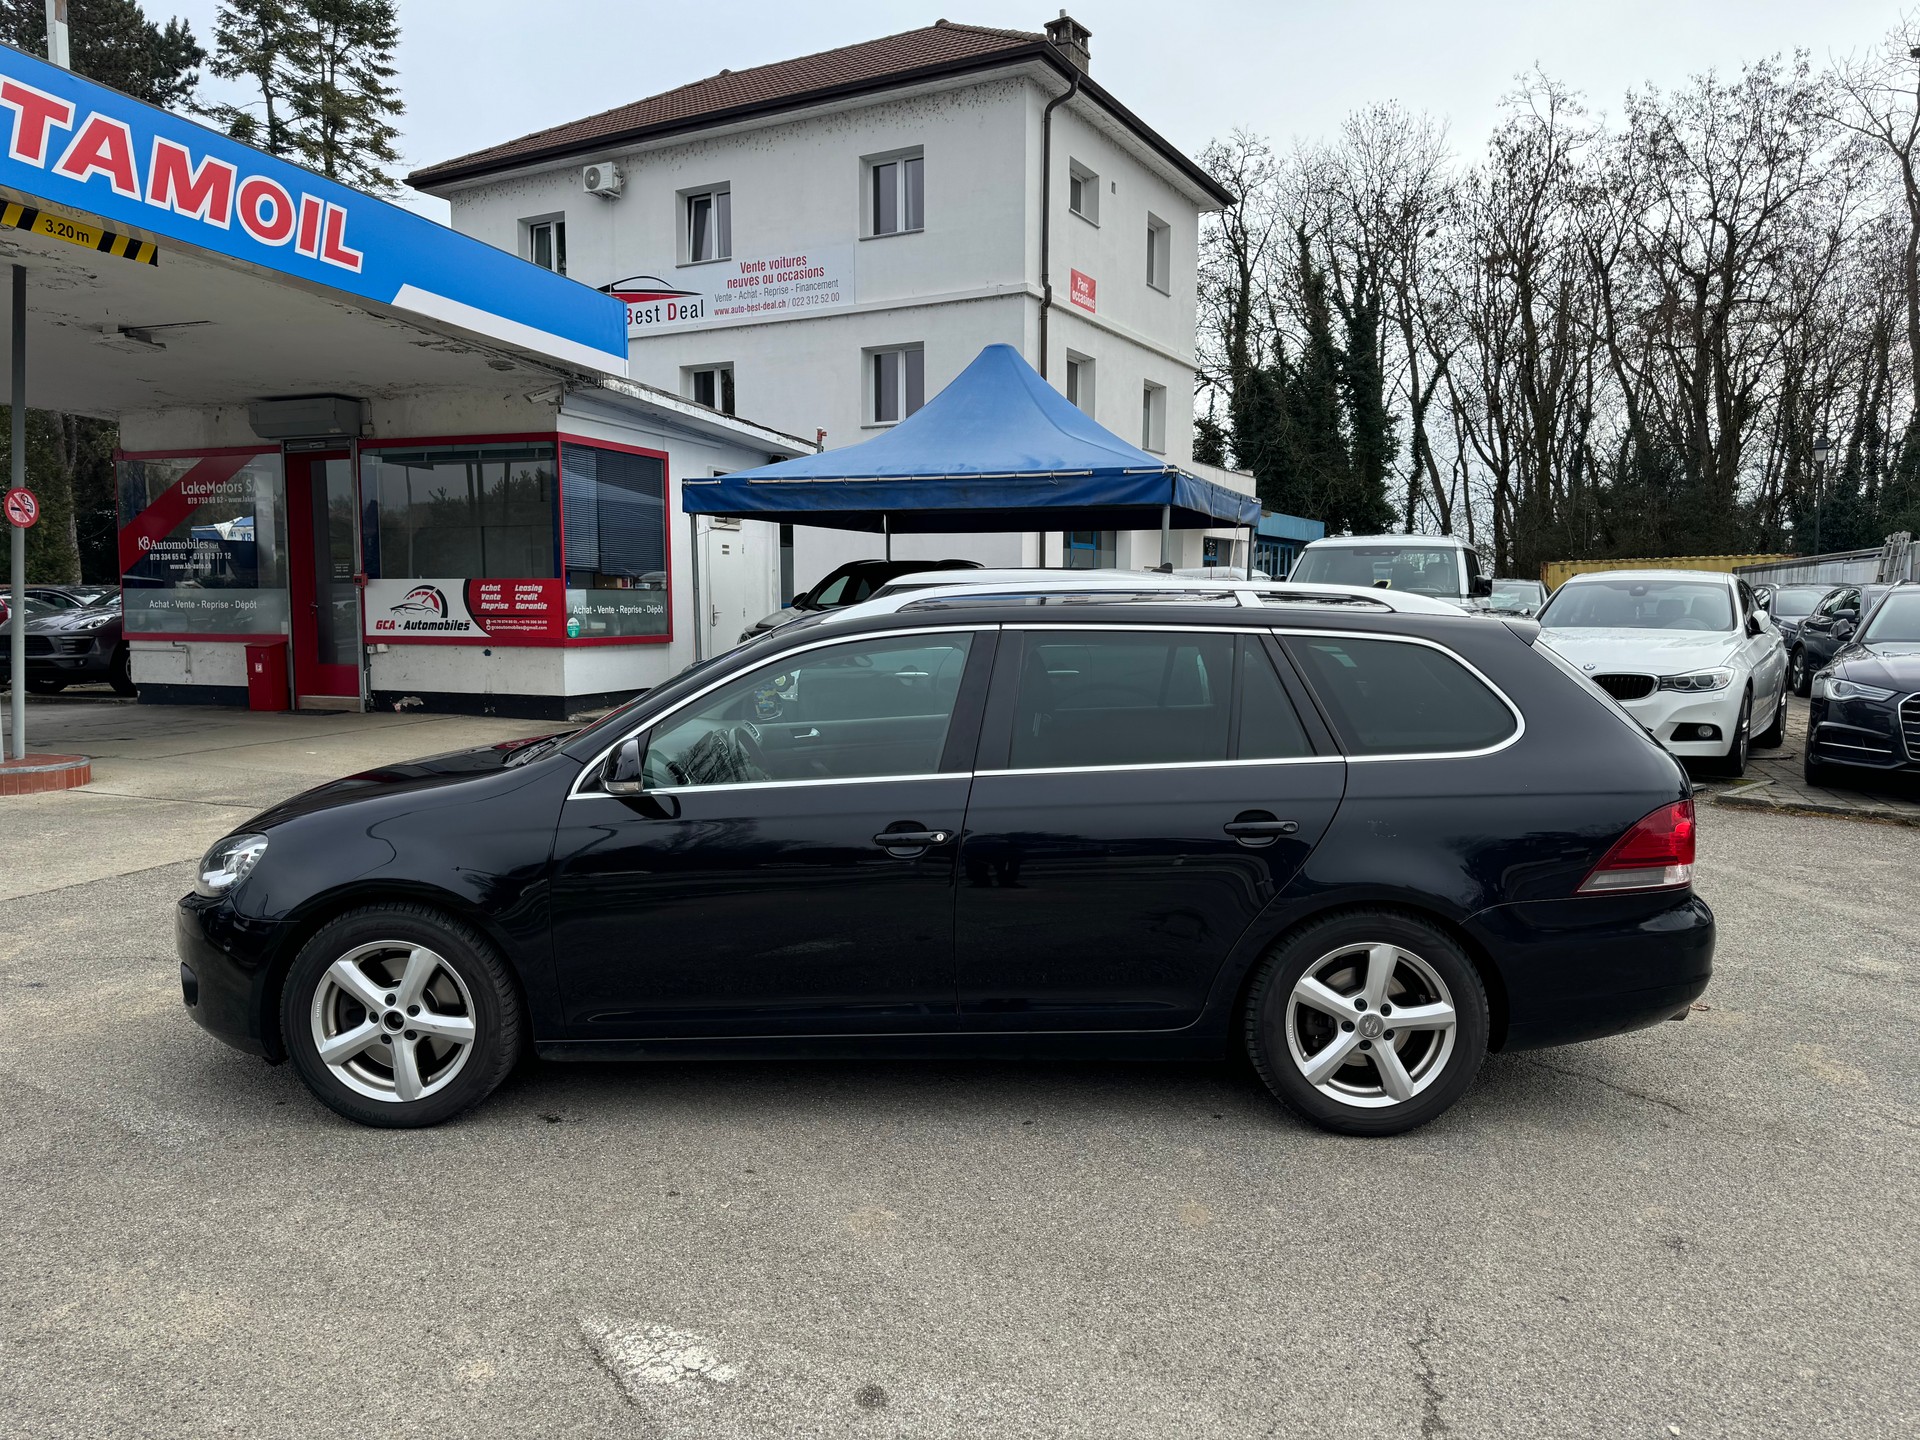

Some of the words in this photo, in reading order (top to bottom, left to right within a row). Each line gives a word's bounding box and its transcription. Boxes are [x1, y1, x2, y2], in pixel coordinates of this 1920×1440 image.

[1, 75, 363, 274] TAMOIL
[45, 219, 74, 239] 3.20
[76, 229, 90, 243] m
[740, 260, 766, 274] Vente
[769, 255, 807, 270] voitures
[727, 276, 760, 289] neuves
[762, 273, 774, 284] ou
[777, 266, 825, 283] occasions
[714, 293, 732, 303] Vente
[738, 290, 758, 300] Achat
[764, 286, 789, 298] Reprise
[795, 278, 839, 293] Financement
[667, 299, 704, 321] Deal
[714, 299, 786, 316] www.auto-best-deal.ch
[792, 297, 804, 307] 022
[806, 295, 819, 305] 312
[820, 293, 829, 303] 52
[830, 292, 840, 302] 00
[181, 480, 243, 495] LakeMotors
[480, 584, 501, 592] Achat
[514, 584, 543, 593] Leasing
[149, 600, 170, 609] Achat
[175, 600, 195, 609] Vente
[201, 600, 229, 610] Reprise
[235, 600, 257, 611] Dépôt
[480, 602, 509, 611] Reprise
[515, 602, 548, 610] Garantie
[573, 605, 592, 615] Achat
[597, 605, 615, 614] Vente
[619, 605, 642, 616] Reprise
[646, 604, 663, 615] Dépôt
[375, 619, 396, 630] GCA
[403, 619, 470, 631] Automobiles
